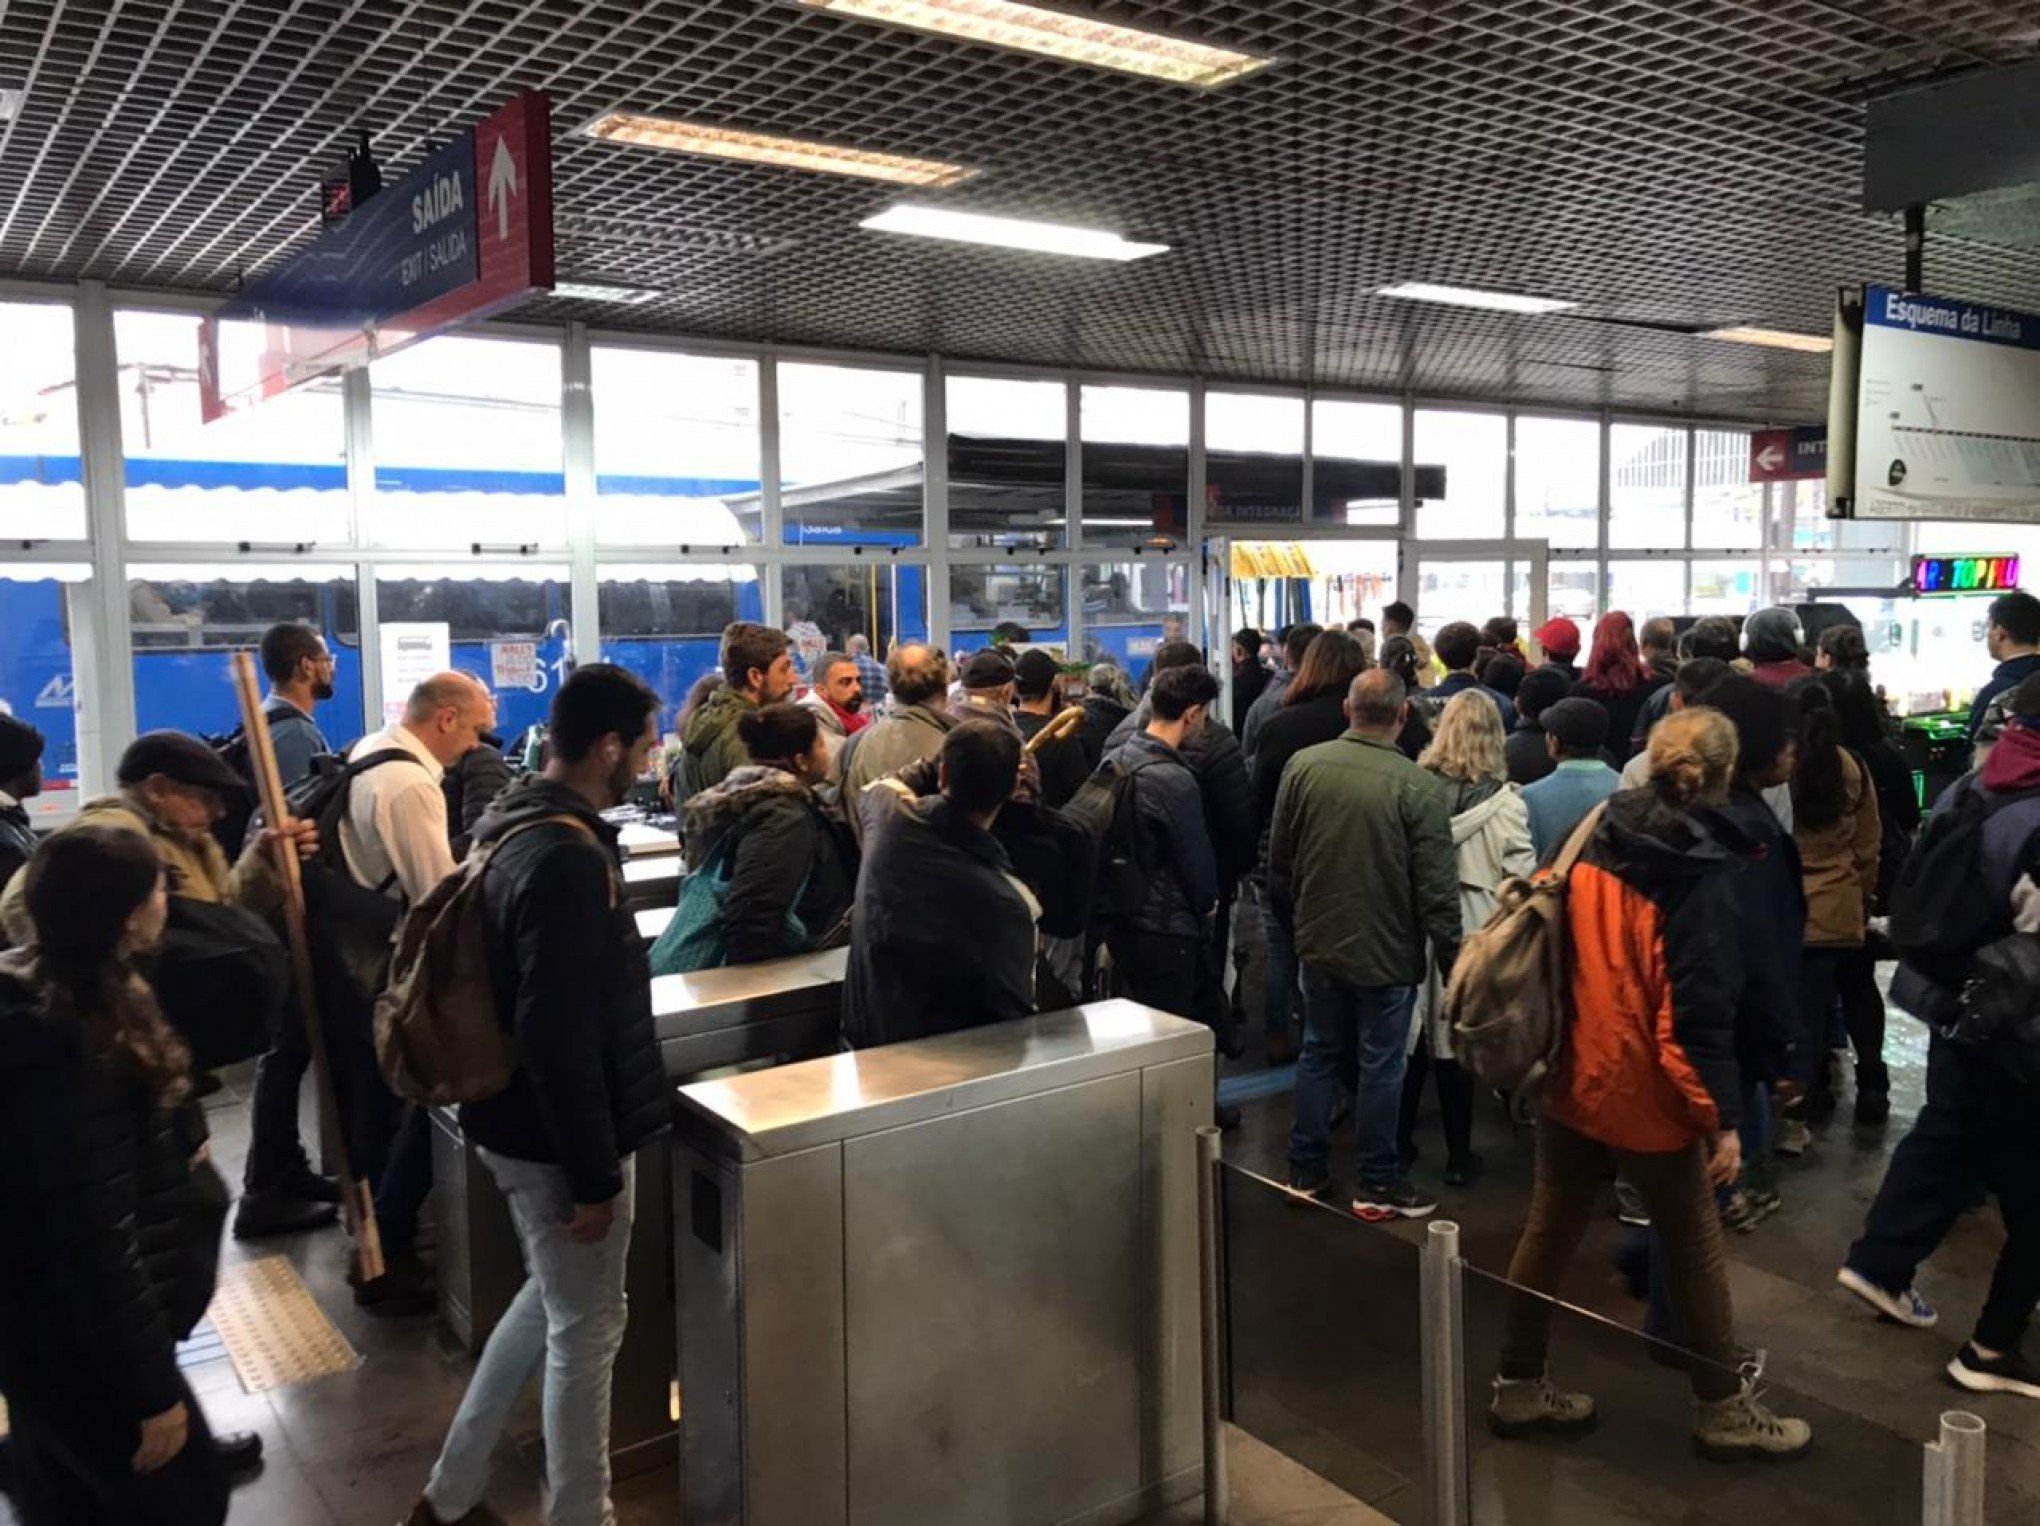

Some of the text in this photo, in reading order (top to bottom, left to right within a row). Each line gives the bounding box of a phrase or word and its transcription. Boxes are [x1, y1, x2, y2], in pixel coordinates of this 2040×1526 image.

[412, 171, 463, 233] SAÍDA
[430, 231, 466, 271] SALIDA
[1886, 293, 2022, 339] Esquema da Linha
